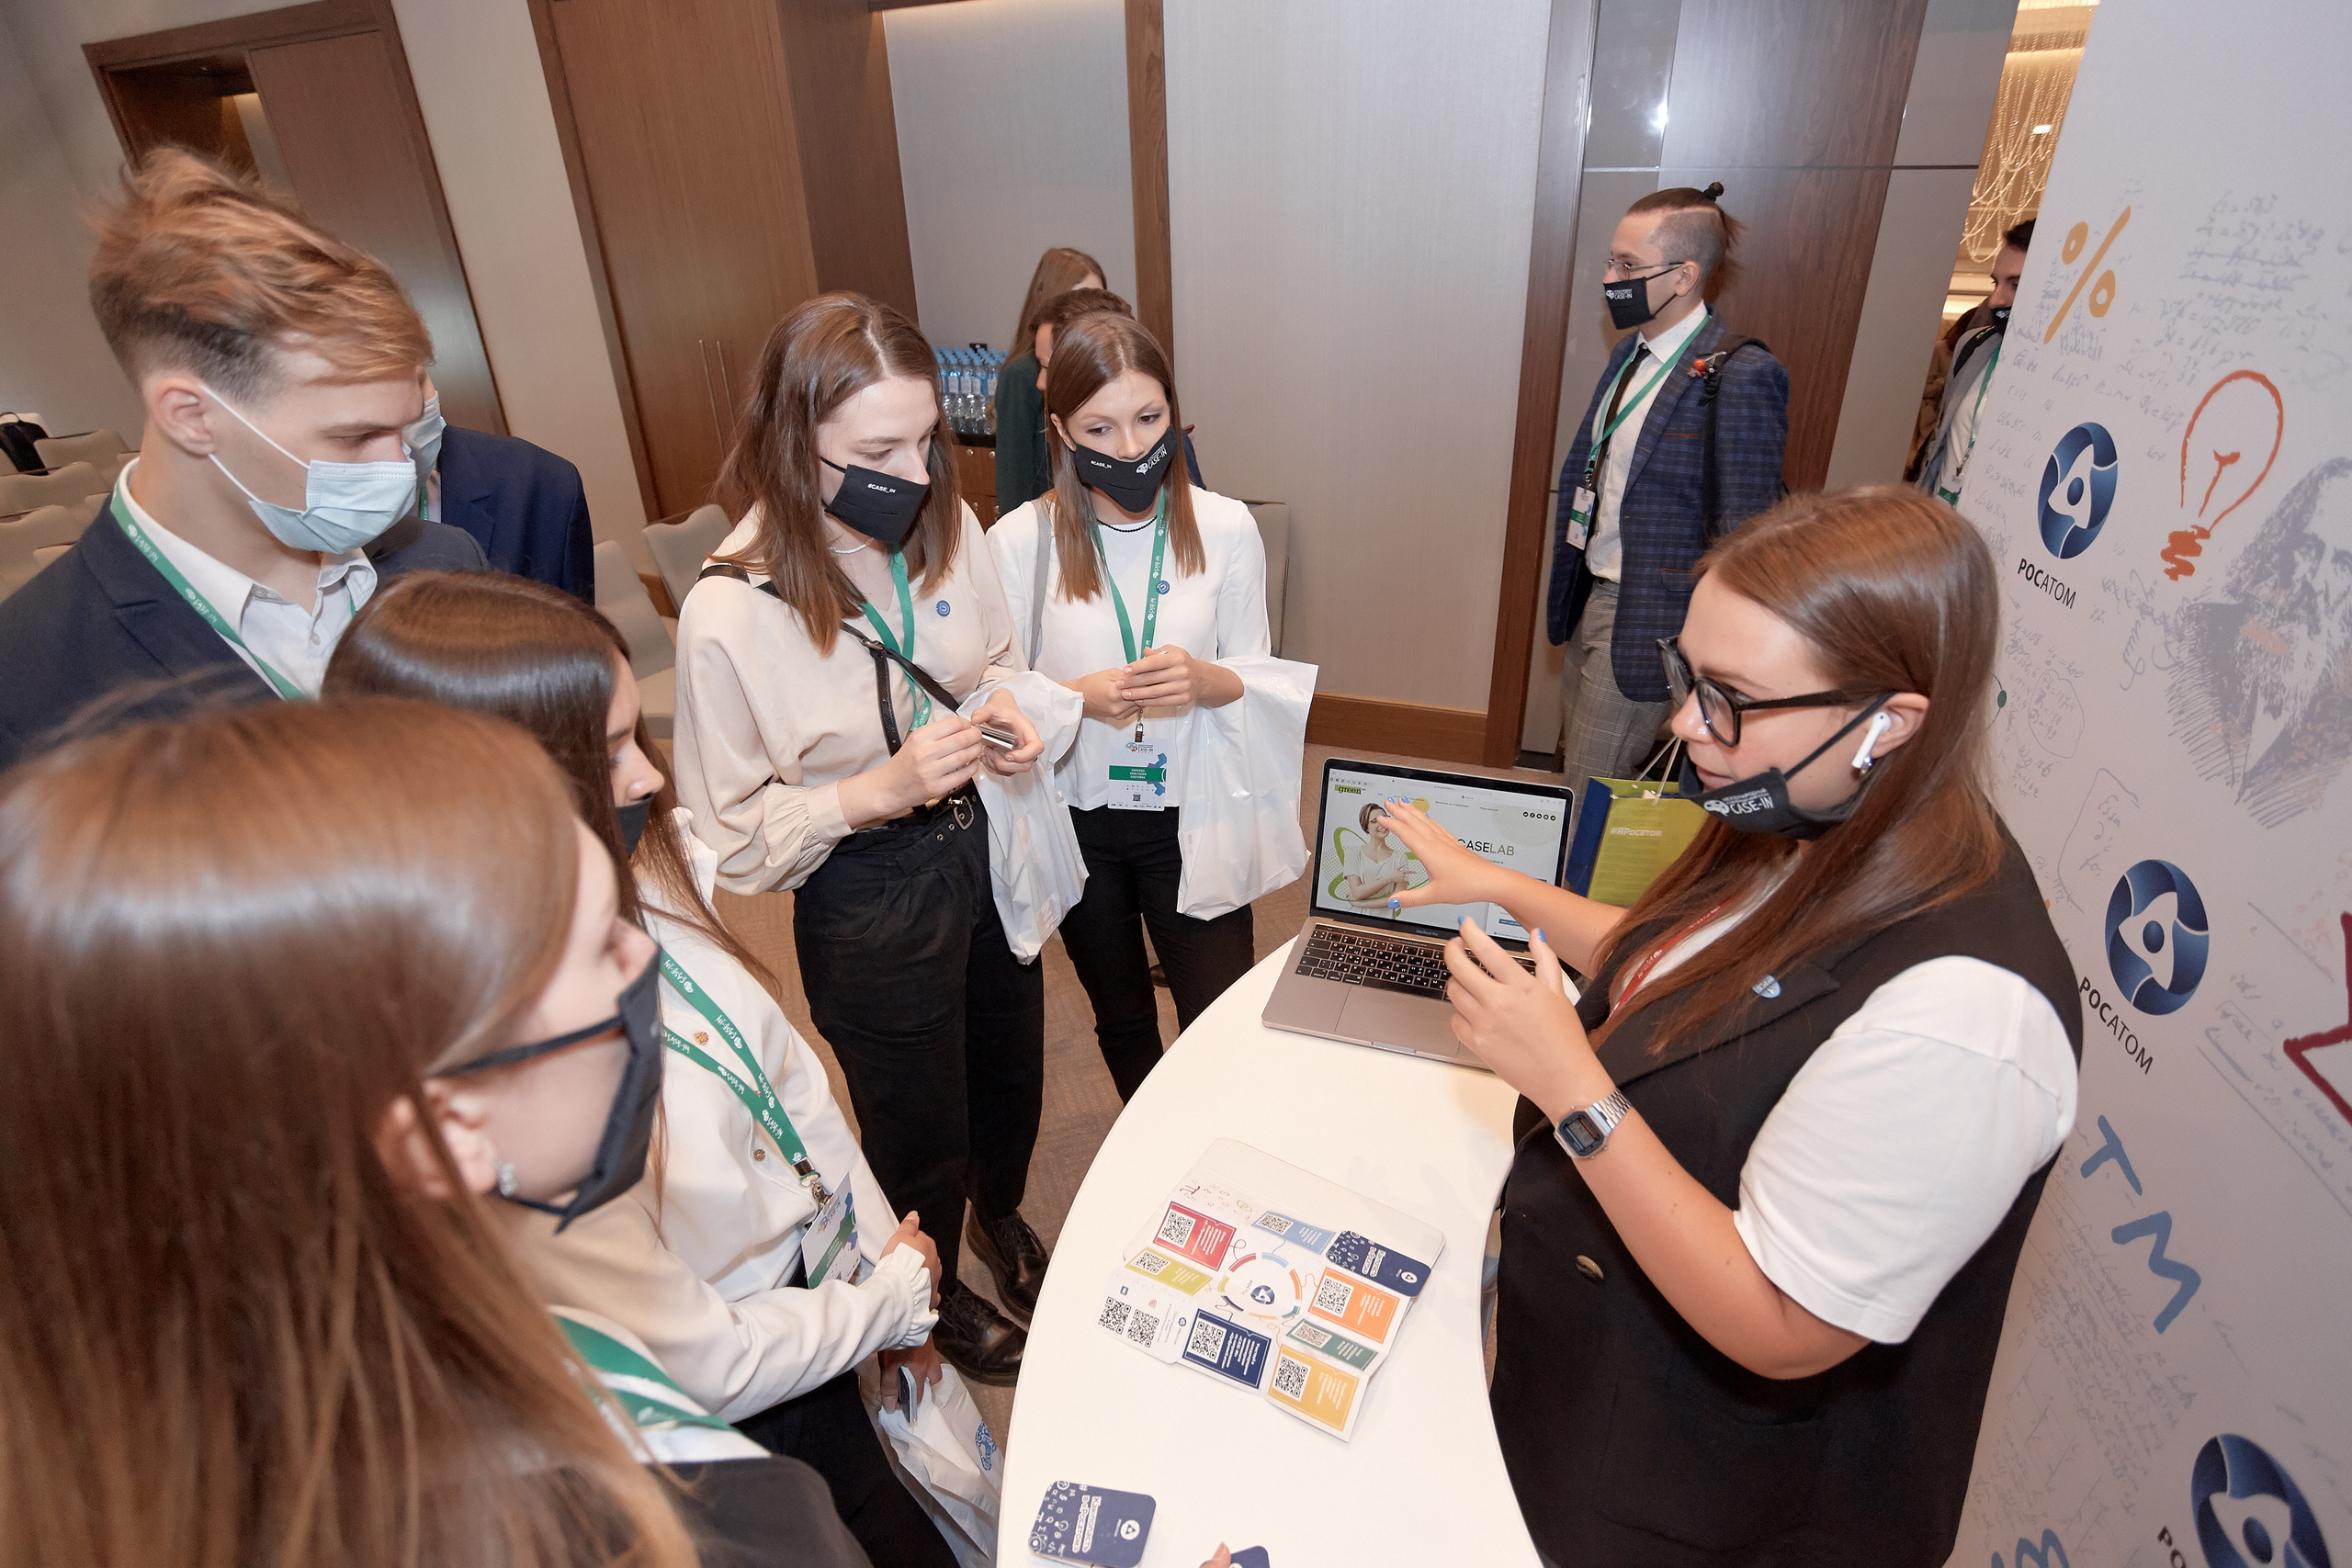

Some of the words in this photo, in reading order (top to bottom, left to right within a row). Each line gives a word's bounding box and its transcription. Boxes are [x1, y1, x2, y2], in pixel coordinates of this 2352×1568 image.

[2018, 558, 2076, 610] РОСАТОМ
[1338, 785, 1362, 795] green
[1729, 795, 1773, 815] CASE-IN
[1611, 828, 1663, 837] #ЯРосатом
[663, 959, 686, 984] CASE-IN
[716, 1014, 737, 1040] CASE-IN
[2079, 976, 2154, 1075] РОСАТОМ
